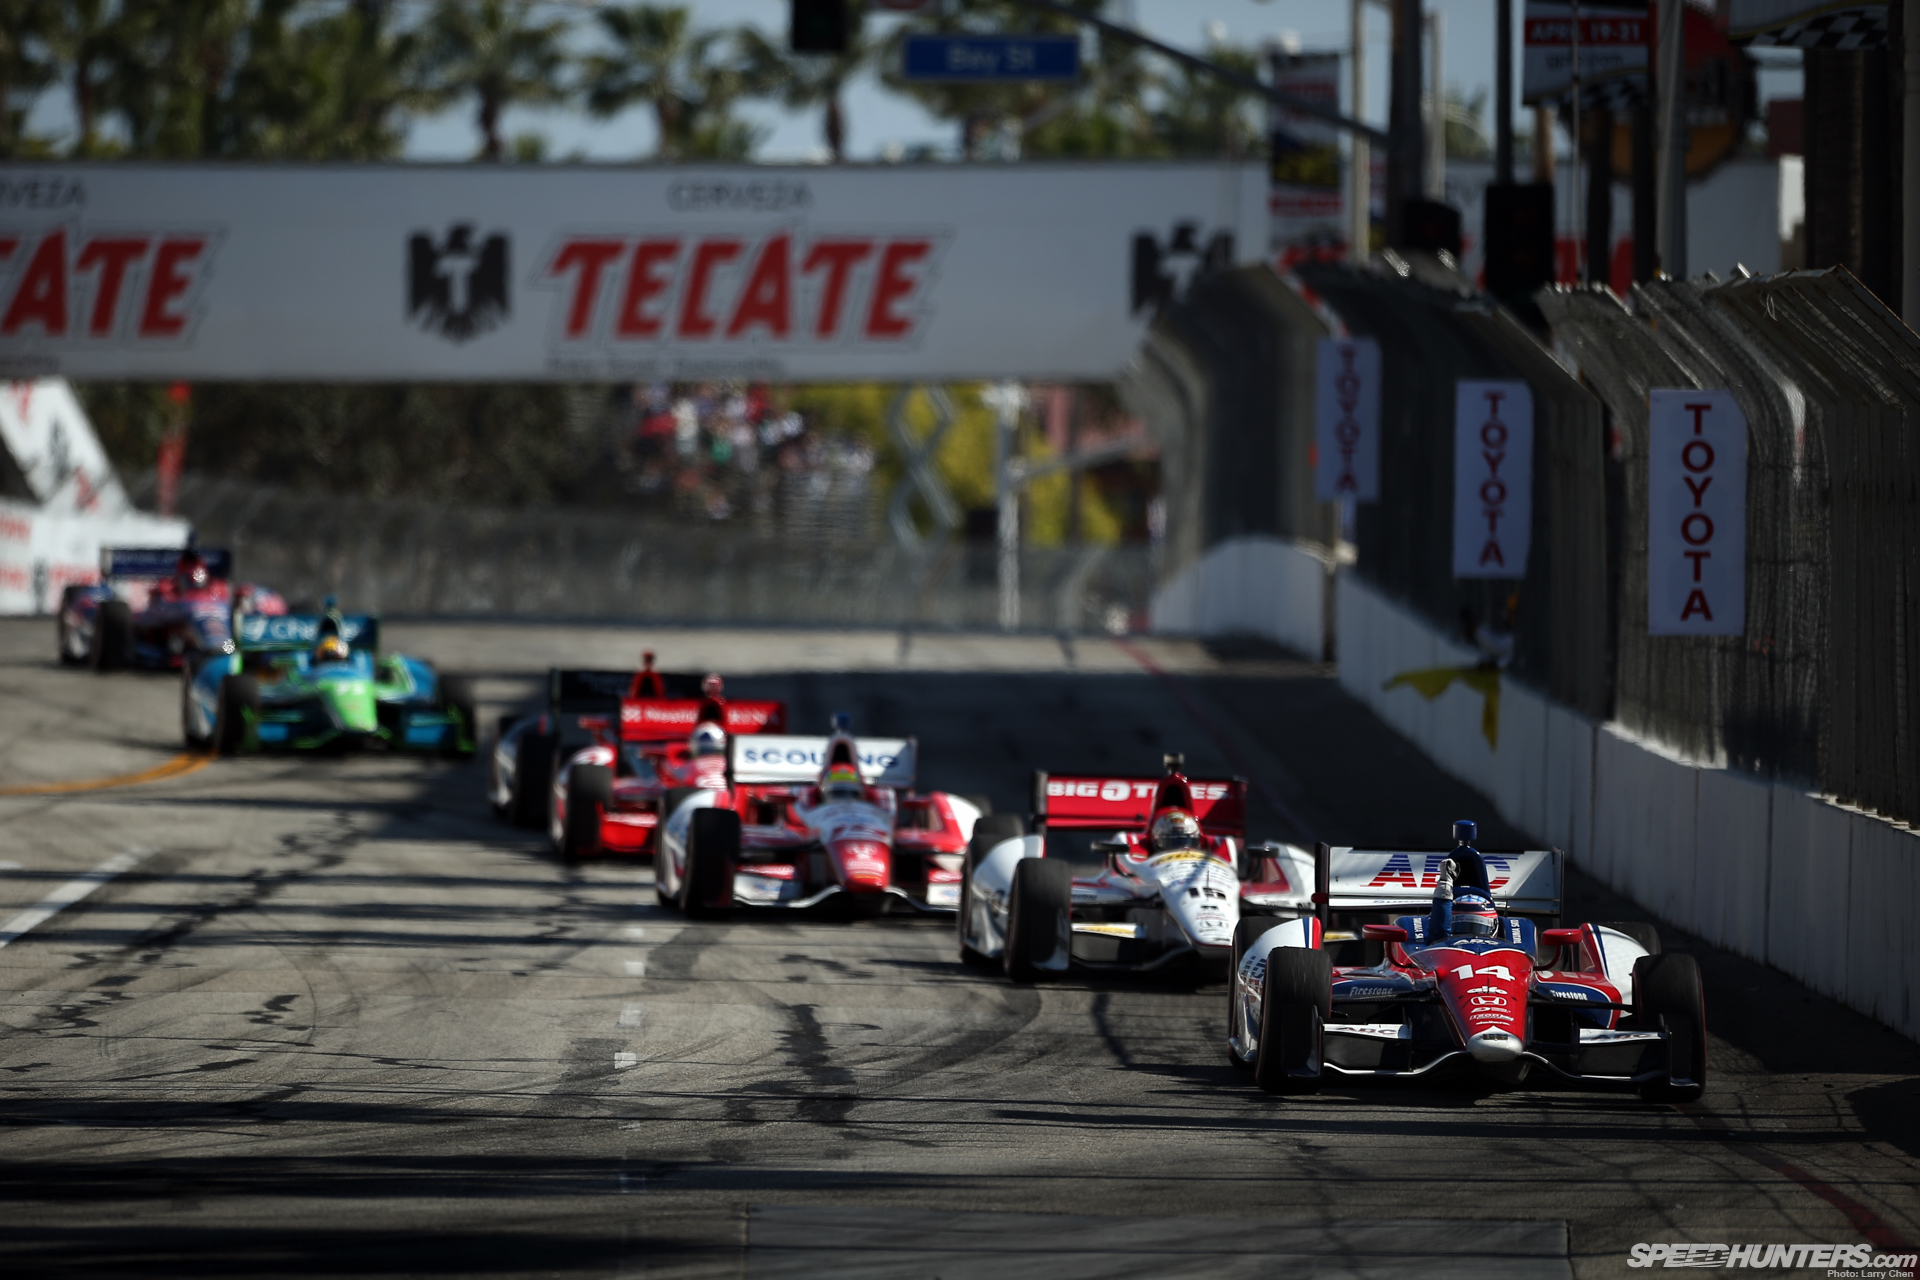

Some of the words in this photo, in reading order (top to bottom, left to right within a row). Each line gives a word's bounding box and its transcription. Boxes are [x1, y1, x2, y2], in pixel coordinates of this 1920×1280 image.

[946, 44, 999, 75] Bay
[1007, 44, 1036, 71] St
[668, 180, 812, 211] CERVEZA
[550, 228, 934, 340] TECATE
[1334, 343, 1362, 494] TOYOTA
[1479, 390, 1508, 568] TOYOTA
[1680, 403, 1716, 622] TOYOTA
[744, 747, 898, 769] SCOUNG
[1047, 781, 1098, 798] BIG
[1133, 784, 1228, 801] TIES
[1450, 964, 1516, 982] 14
[1350, 986, 1394, 998] Firestone
[1549, 989, 1589, 1001] Firestone
[1336, 1026, 1398, 1036] ABC
